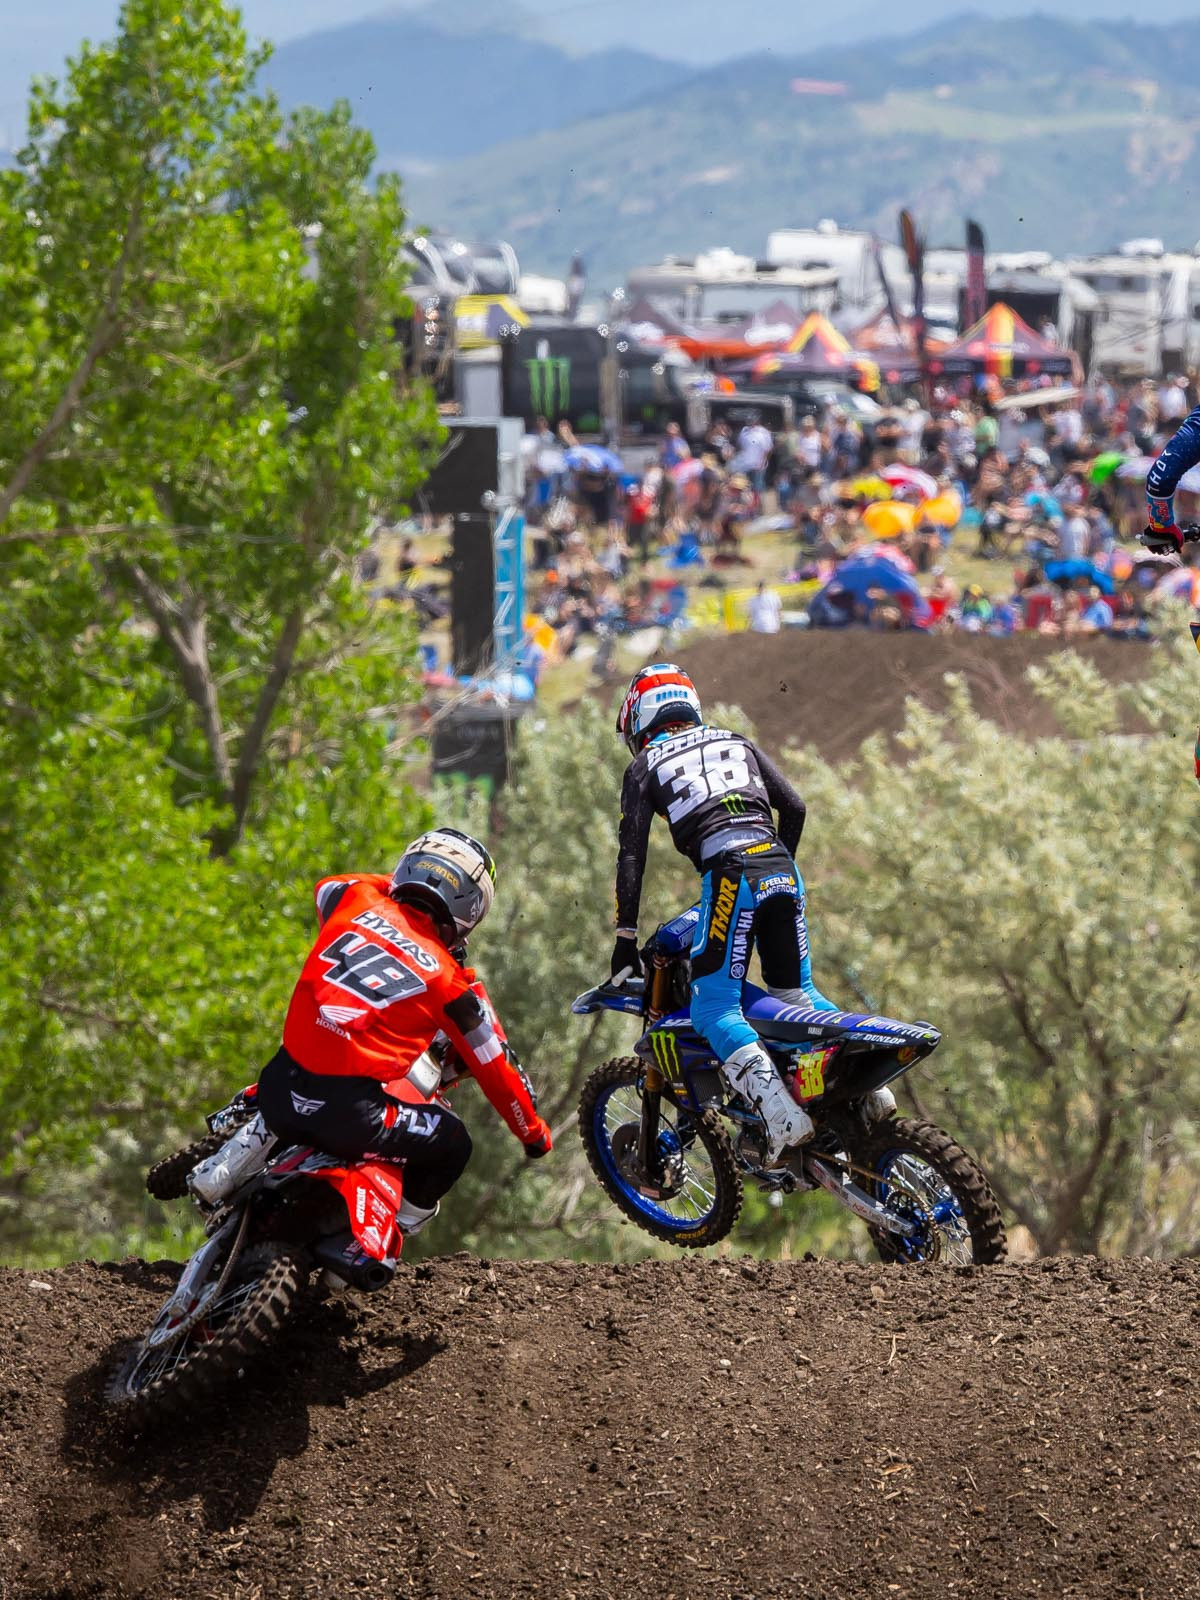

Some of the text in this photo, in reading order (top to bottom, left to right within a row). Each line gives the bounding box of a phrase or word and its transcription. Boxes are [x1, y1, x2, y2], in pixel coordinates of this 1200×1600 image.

[656, 740, 750, 825] 38
[709, 876, 738, 942] THOR
[351, 911, 440, 972] HYMAS
[731, 910, 755, 962] YAMAHA
[319, 931, 428, 1010] 48
[315, 1017, 352, 1041] HONDA
[863, 1034, 907, 1045] DUNLOP
[799, 1051, 826, 1098] 38
[393, 1104, 442, 1137] FLY
